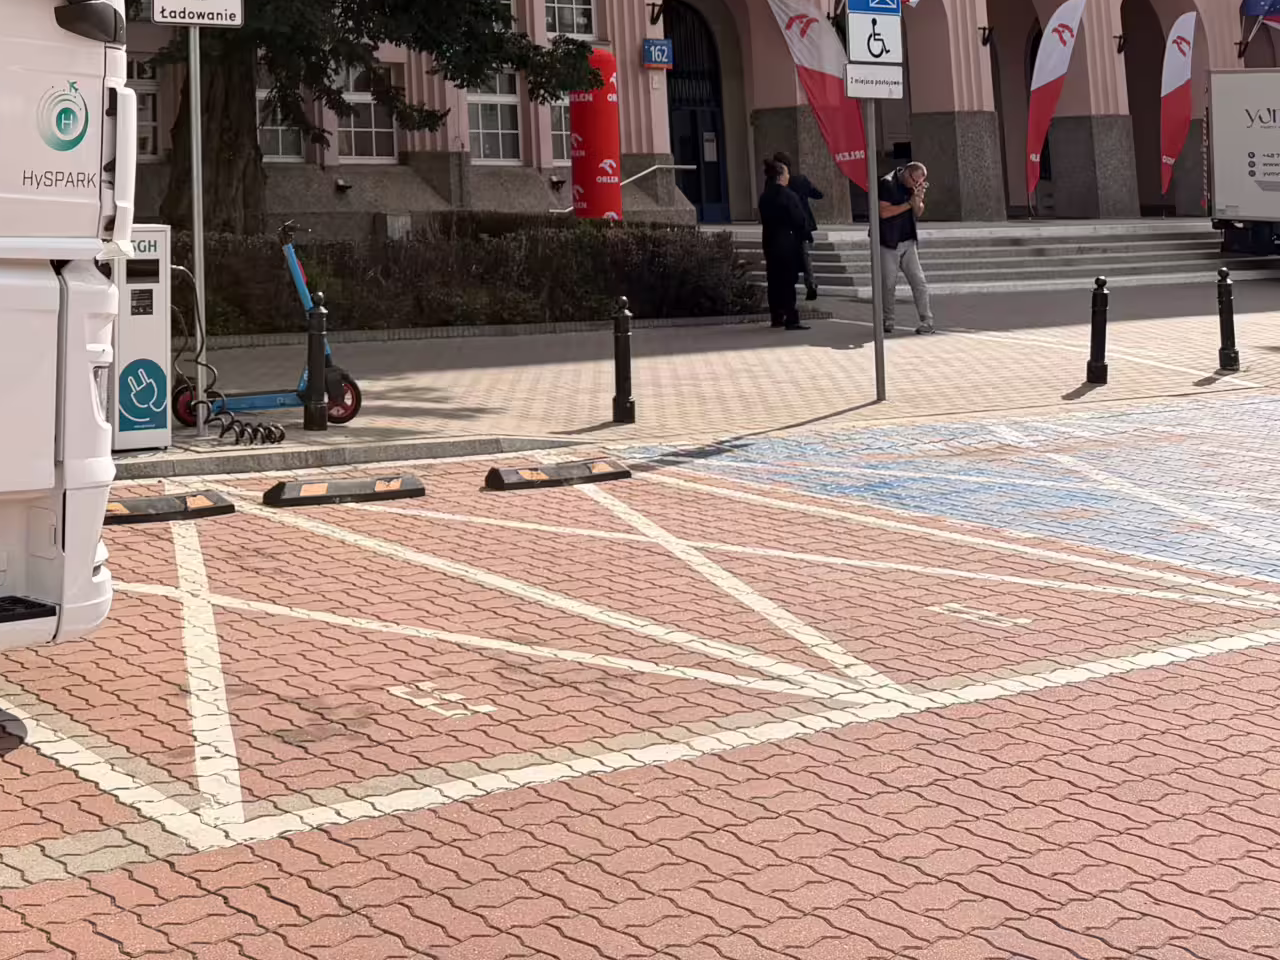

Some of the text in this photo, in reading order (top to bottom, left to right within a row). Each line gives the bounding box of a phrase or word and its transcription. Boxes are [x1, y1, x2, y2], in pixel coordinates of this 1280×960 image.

[159, 5, 237, 22] Ładowanie
[649, 45, 669, 62] 162
[850, 76, 854, 84] 2
[22, 169, 97, 190] HySPARK
